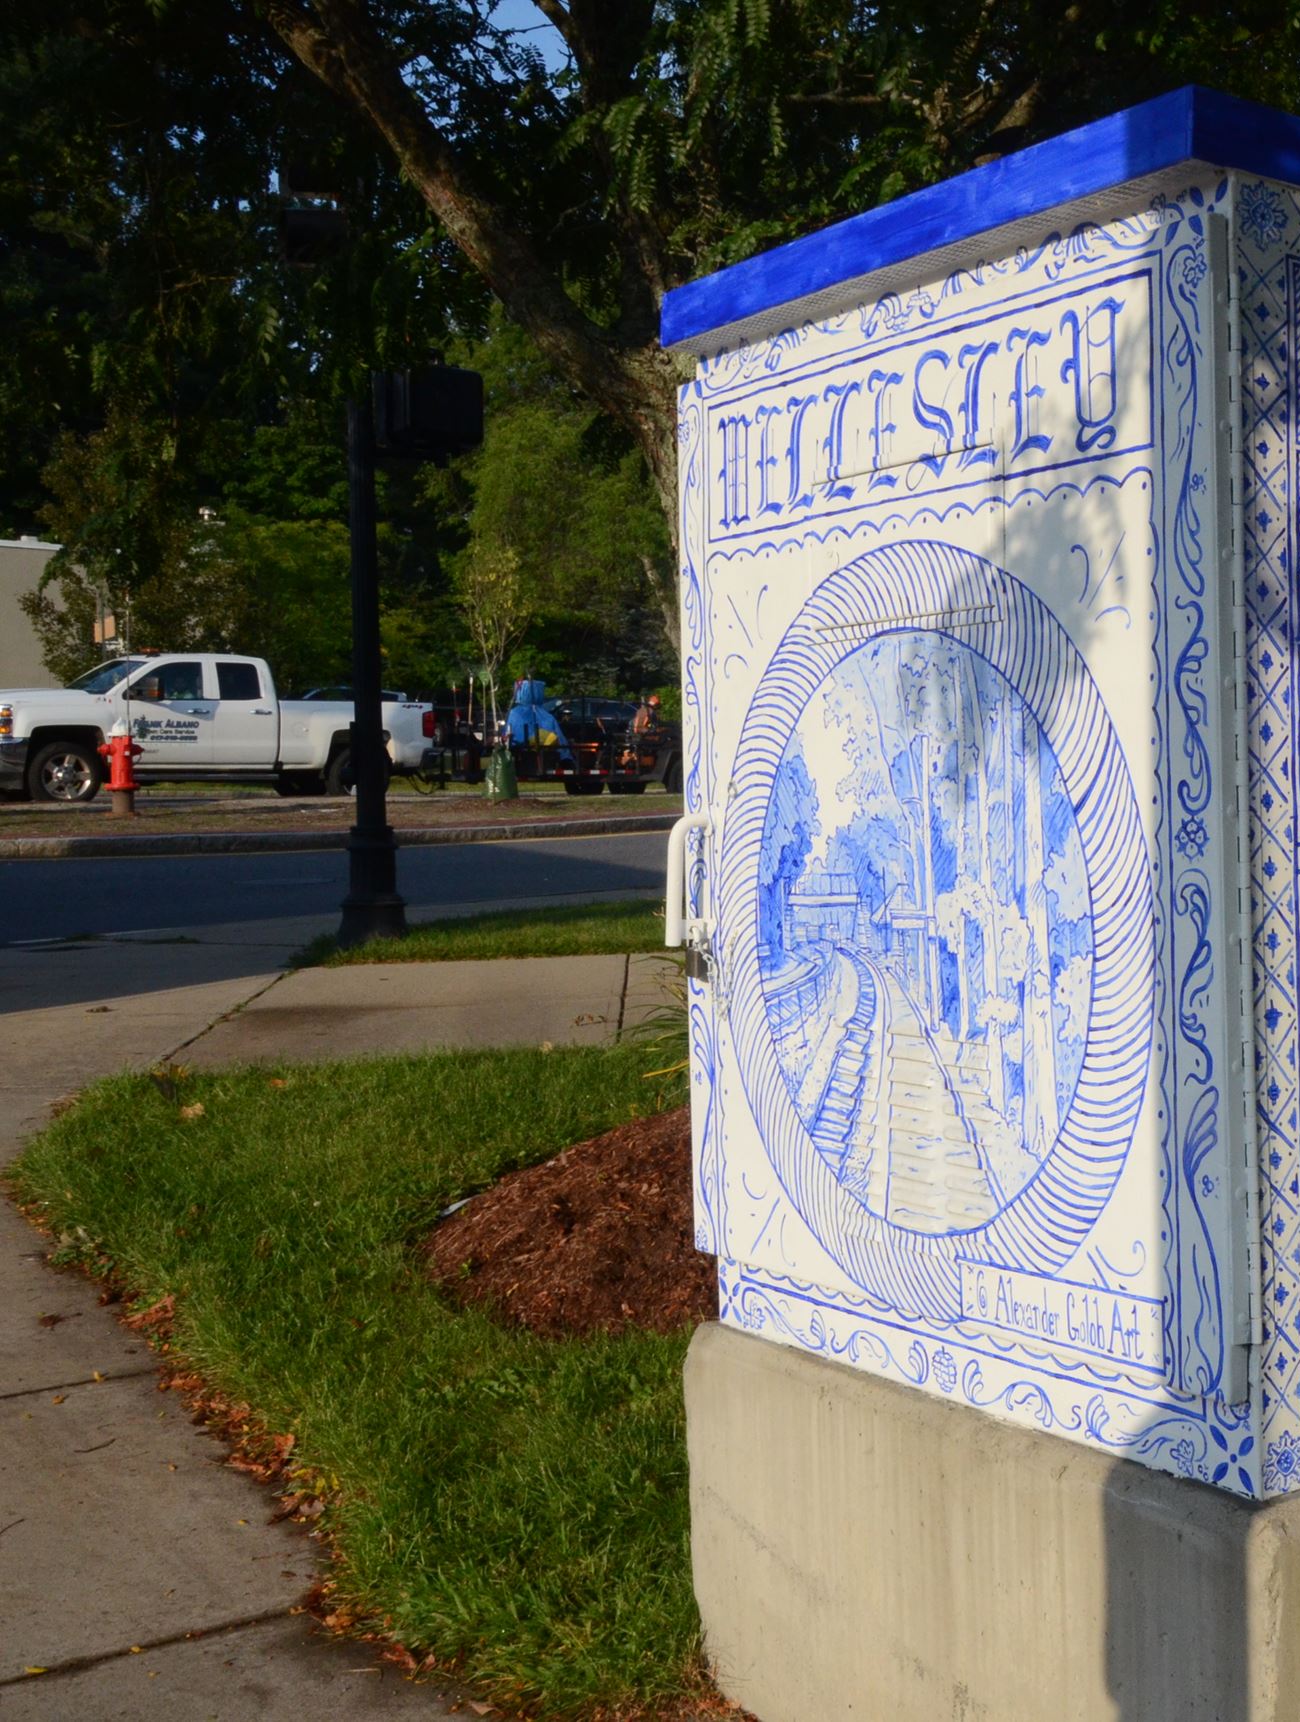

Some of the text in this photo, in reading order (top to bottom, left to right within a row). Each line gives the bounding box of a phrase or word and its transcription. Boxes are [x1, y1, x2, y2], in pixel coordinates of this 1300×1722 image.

[718, 296, 1125, 530] WELLESLEY
[165, 718, 200, 729] ALBANO
[995, 1275, 1060, 1337] Alexander
[1066, 1292, 1105, 1349] Golob
[1107, 1299, 1144, 1360] Art
